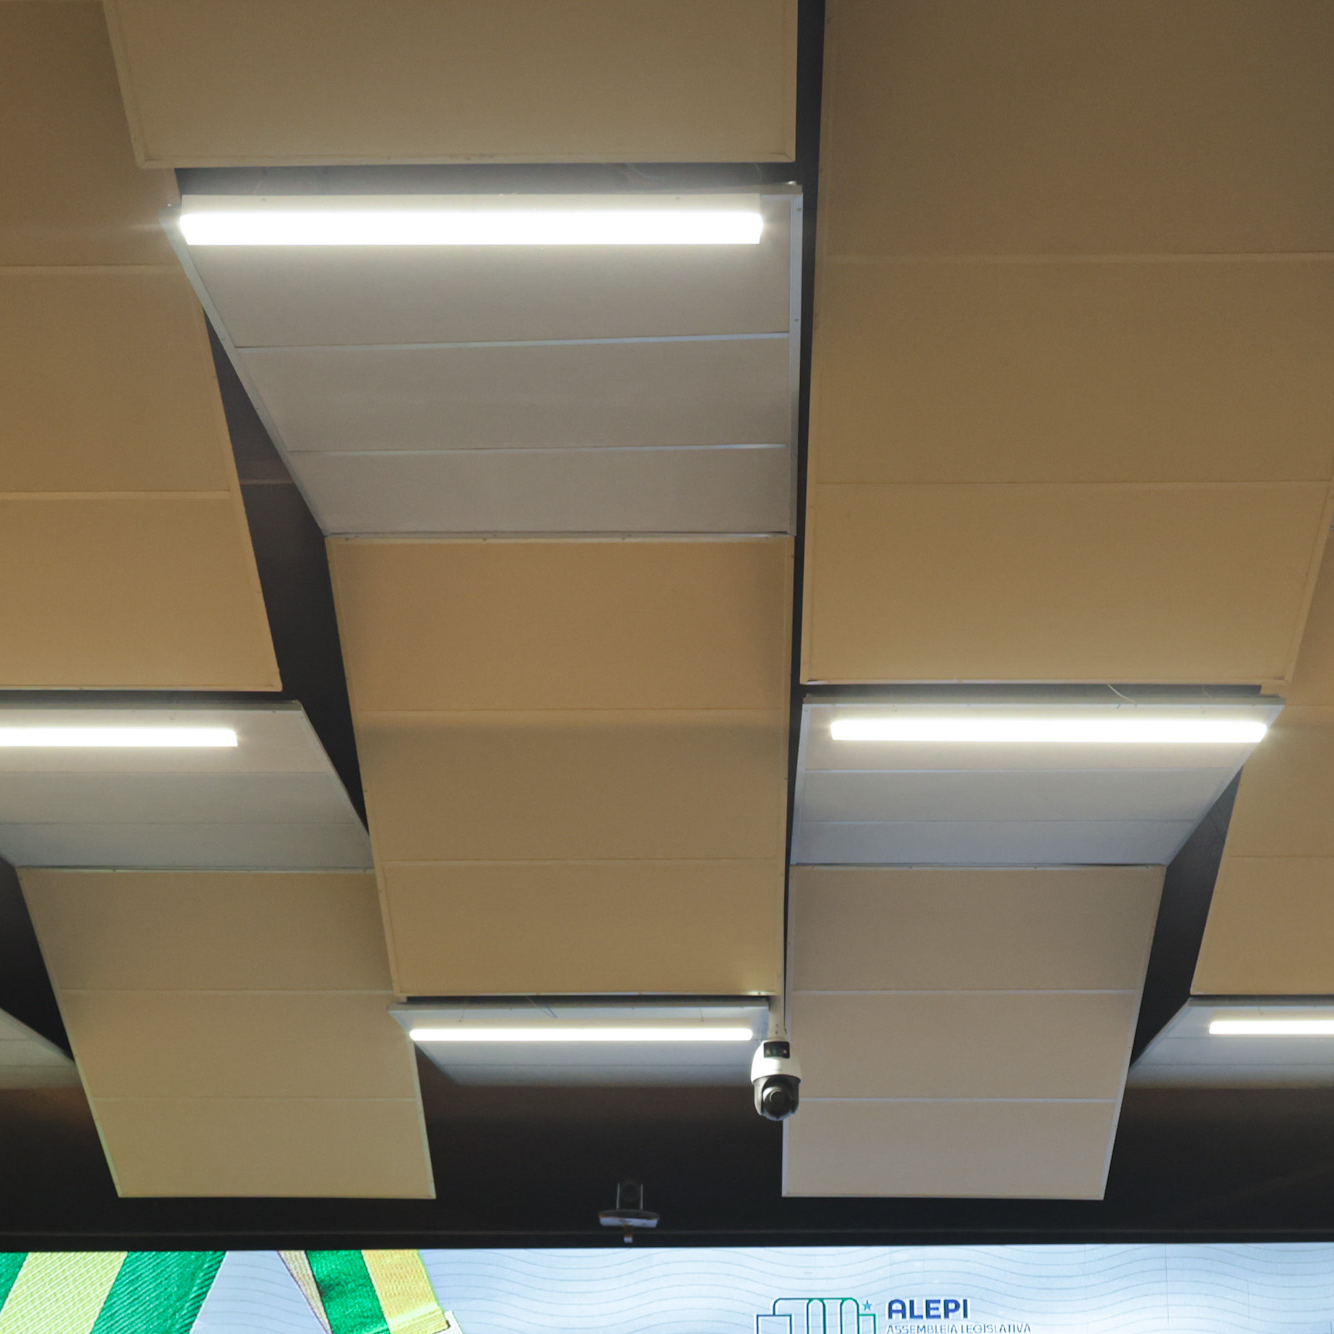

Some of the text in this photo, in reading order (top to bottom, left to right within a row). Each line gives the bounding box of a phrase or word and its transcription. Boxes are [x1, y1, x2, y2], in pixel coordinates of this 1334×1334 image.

[887, 1298, 968, 1320] ALEPI
[886, 1323, 1031, 1334] ASSEMBLEIA LEGISLATIVA
